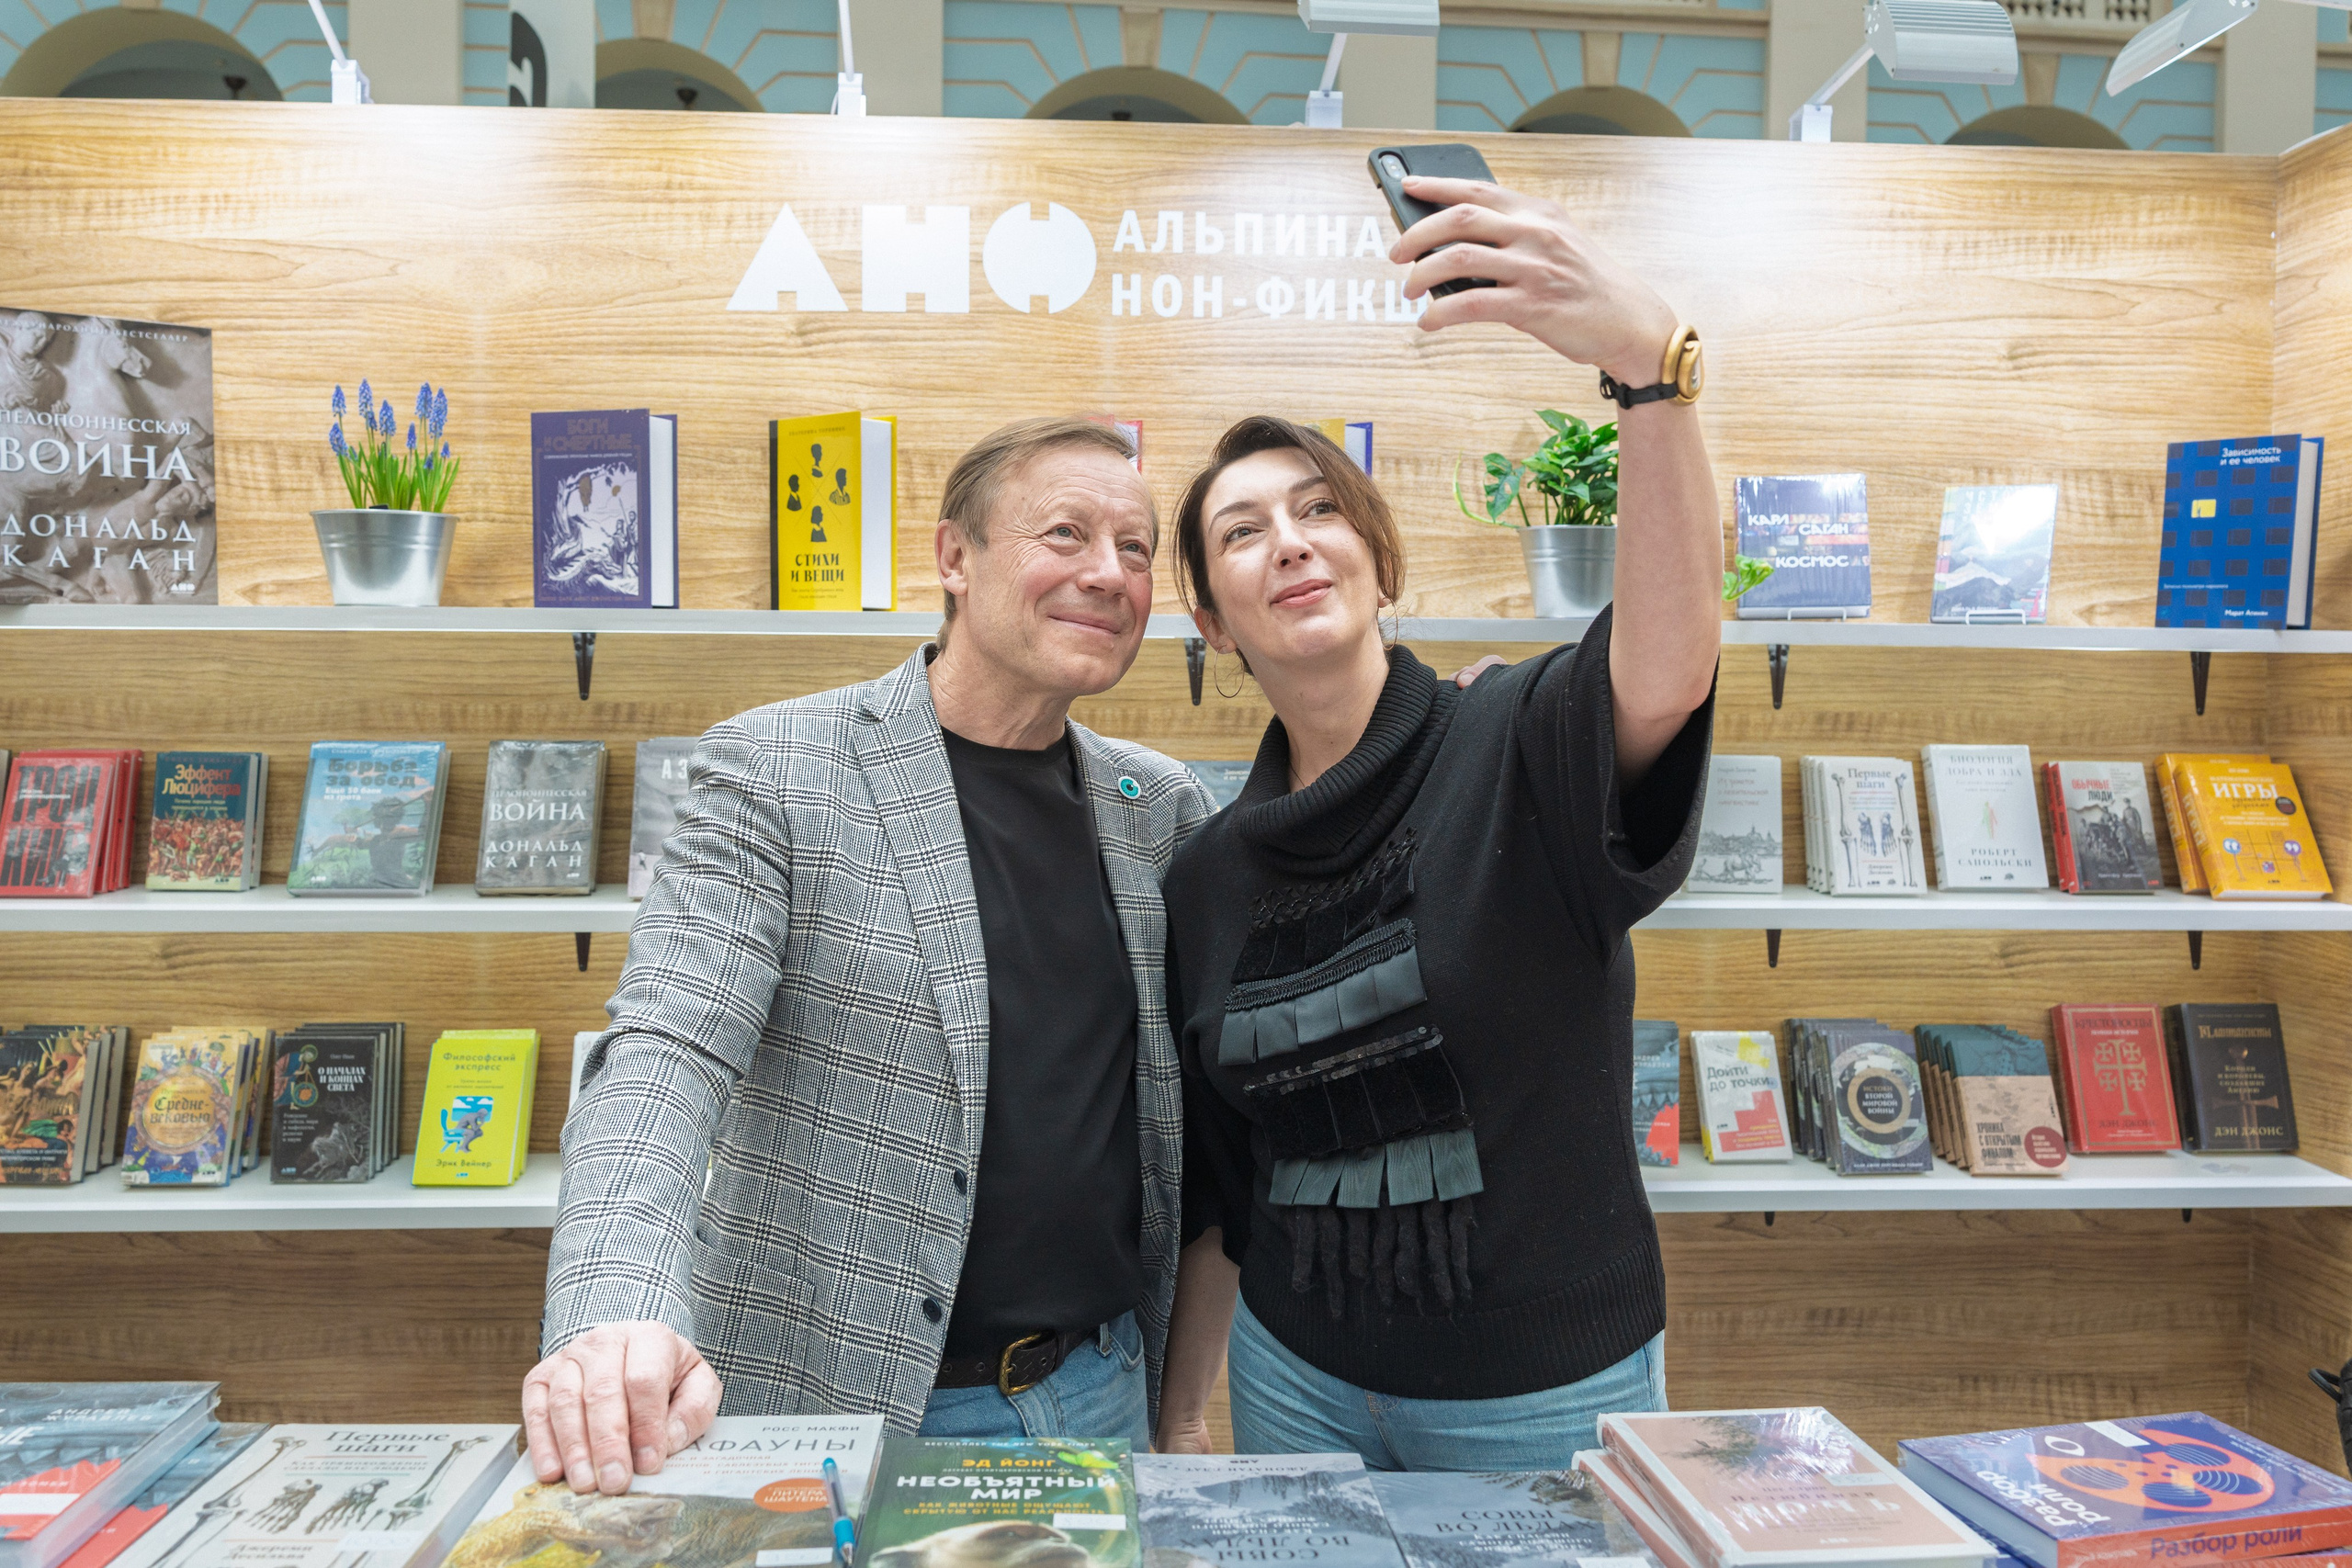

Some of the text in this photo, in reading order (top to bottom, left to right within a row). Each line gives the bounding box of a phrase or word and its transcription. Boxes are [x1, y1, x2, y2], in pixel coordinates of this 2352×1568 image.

[1113, 209, 1387, 258] АЛЬПИНА
[1113, 273, 1429, 323] НОН-ФИКШ
[0, 409, 191, 436] ПЕЛОПОННЕССКАЯ
[566, 417, 609, 434] БОГИ
[0, 433, 197, 482] ВОЙНА
[2222, 446, 2282, 458] Зависимость
[2220, 457, 2227, 466] и
[2242, 454, 2281, 465] человек
[1747, 513, 1790, 526] КАРЛ
[1, 513, 197, 543] ДОНАЛЬД
[1798, 522, 1849, 536] САГАН
[795, 553, 840, 567] СТИХИ
[1775, 554, 1850, 569] КОСМОС
[791, 569, 844, 583] И ВЕЩИ
[328, 758, 418, 775] Борьба
[1949, 755, 2014, 765] БИОЛОГИЯ
[174, 763, 233, 784] Эффект
[1847, 767, 1892, 781] Первые
[325, 773, 416, 789] за обед
[1856, 780, 1886, 789] шаги
[161, 777, 242, 800] Люцифера
[2211, 782, 2279, 800] ИГРЫ
[2087, 790, 2113, 803] ЛЮДИ
[489, 798, 587, 822] ВОЙНА
[485, 840, 583, 852] ДОНАЛЬД
[1970, 848, 2017, 857] РОБЕРТ
[1957, 859, 2032, 868] САПОЛЬСКИ
[443, 1052, 516, 1064] Философский
[317, 1066, 367, 1076] О НАЧАЛАХ
[454, 1063, 502, 1073] экспресс
[1706, 1065, 1749, 1081] Дойти
[319, 1075, 364, 1084] И КОНЦАХ
[326, 1083, 356, 1092] СВЕТА
[1709, 1080, 1727, 1093] до
[1867, 1107, 1895, 1115] ВОЙНЫ
[2214, 1125, 2284, 1137] ДЭН ДЖОНС
[435, 1158, 492, 1168] Эрик Вейнер
[322, 1430, 451, 1444] Первые
[333, 1443, 419, 1453] шаги
[961, 1457, 1057, 1469] ЭД ЙОНГ
[896, 1473, 1116, 1488] НЕОБЪЯТНЫЙ
[771, 1489, 824, 1497] ПИТЕРА
[969, 1488, 1044, 1501] МИР
[1976, 1469, 2078, 1528] Разбор
[2029, 1483, 2112, 1524] роли
[1461, 1509, 1556, 1521] СОВЫ
[1435, 1519, 1598, 1533] ВО ЛЬДАХ
[1305, 1535, 1351, 1547] ВО
[2150, 1531, 2239, 1560] Разбор
[2244, 1525, 2304, 1553] роли
[1216, 1549, 1320, 1562] СОВЫ
